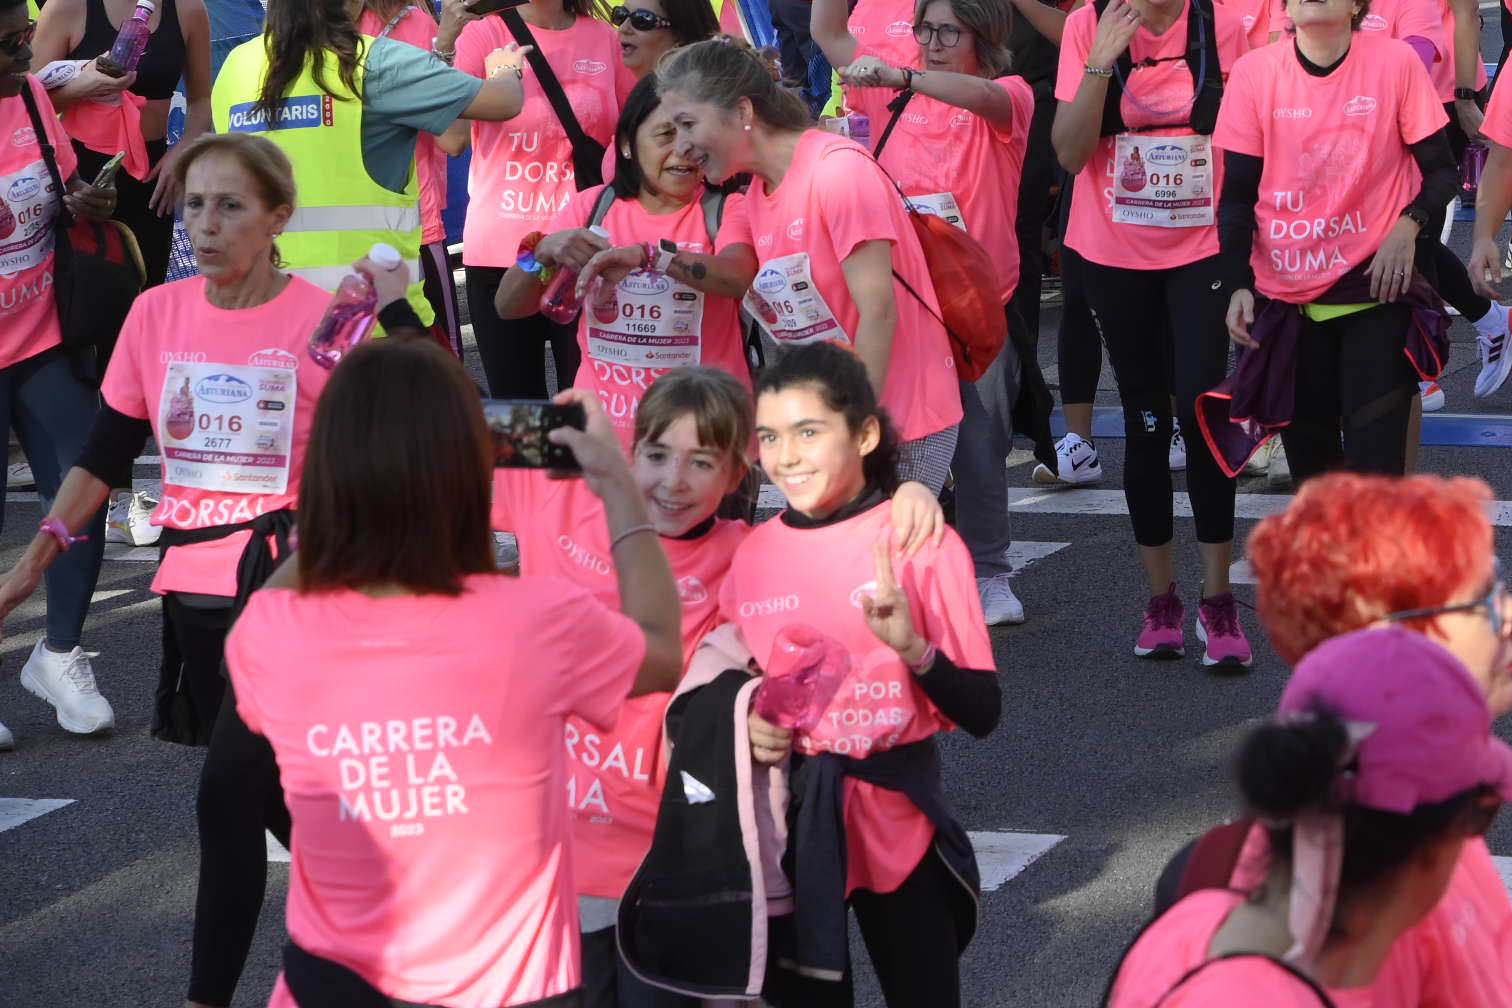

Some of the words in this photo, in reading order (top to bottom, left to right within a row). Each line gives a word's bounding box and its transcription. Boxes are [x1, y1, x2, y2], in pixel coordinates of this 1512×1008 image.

[510, 132, 541, 153] TU
[1149, 173, 1184, 186] 016
[1155, 190, 1177, 199] 6996
[1273, 190, 1304, 214] TU
[18, 203, 42, 225] 016
[1270, 210, 1367, 241] DORSAL
[1271, 247, 1348, 273] SUMA
[622, 303, 662, 320] 016
[625, 323, 656, 334] 11669
[655, 350, 692, 360] Santander
[198, 413, 242, 432] 016
[204, 436, 231, 448] 2677
[233, 472, 277, 483] Santander
[559, 534, 610, 576] OYSHO
[739, 594, 800, 617] OYSHO
[854, 680, 902, 700] POR
[829, 707, 903, 729] TODAS
[305, 712, 491, 758] CARRERA
[563, 722, 650, 781] RSAL
[339, 753, 394, 790] DE
[406, 749, 458, 786] LA
[337, 783, 468, 823] MUJER
